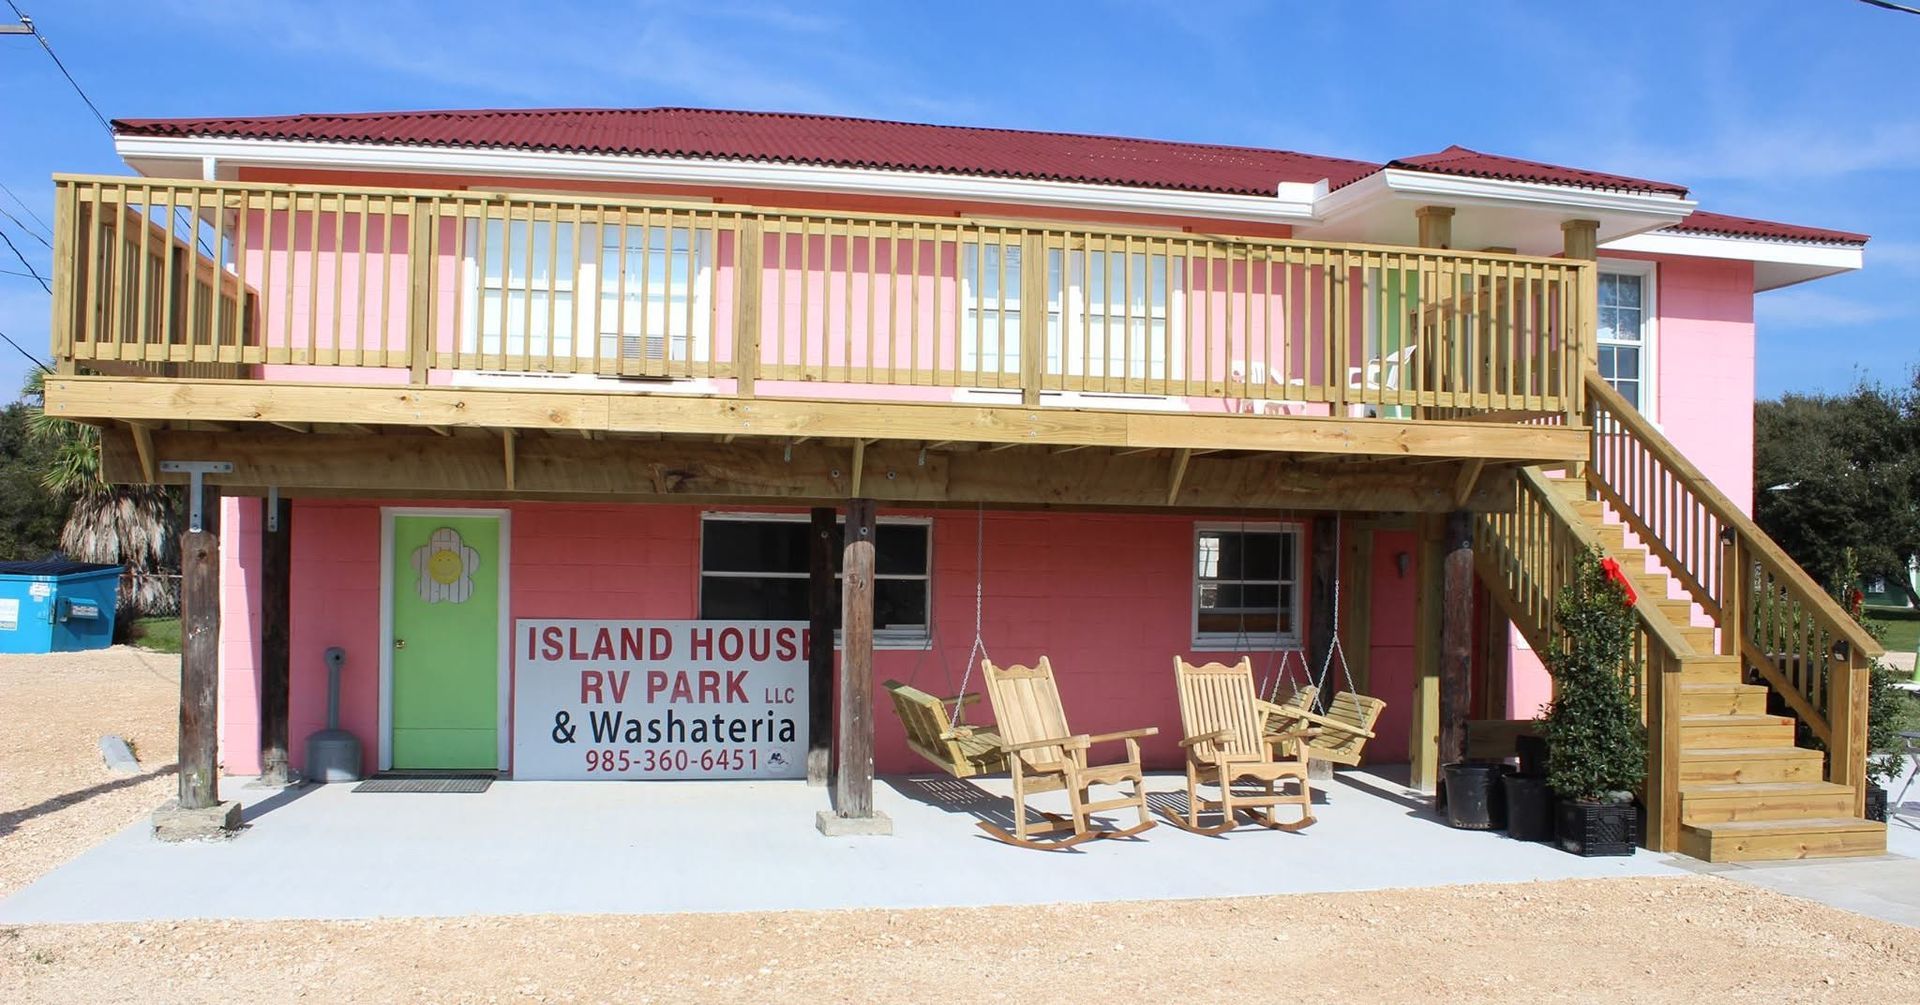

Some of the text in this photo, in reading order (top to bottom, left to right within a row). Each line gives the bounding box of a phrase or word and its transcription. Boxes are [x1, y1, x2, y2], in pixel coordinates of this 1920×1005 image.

[528, 626, 672, 661] ISLAND
[580, 670, 795, 704] RV PARK LLC
[552, 709, 795, 744] & Washateria
[585, 749, 757, 772] 985-360-6451
